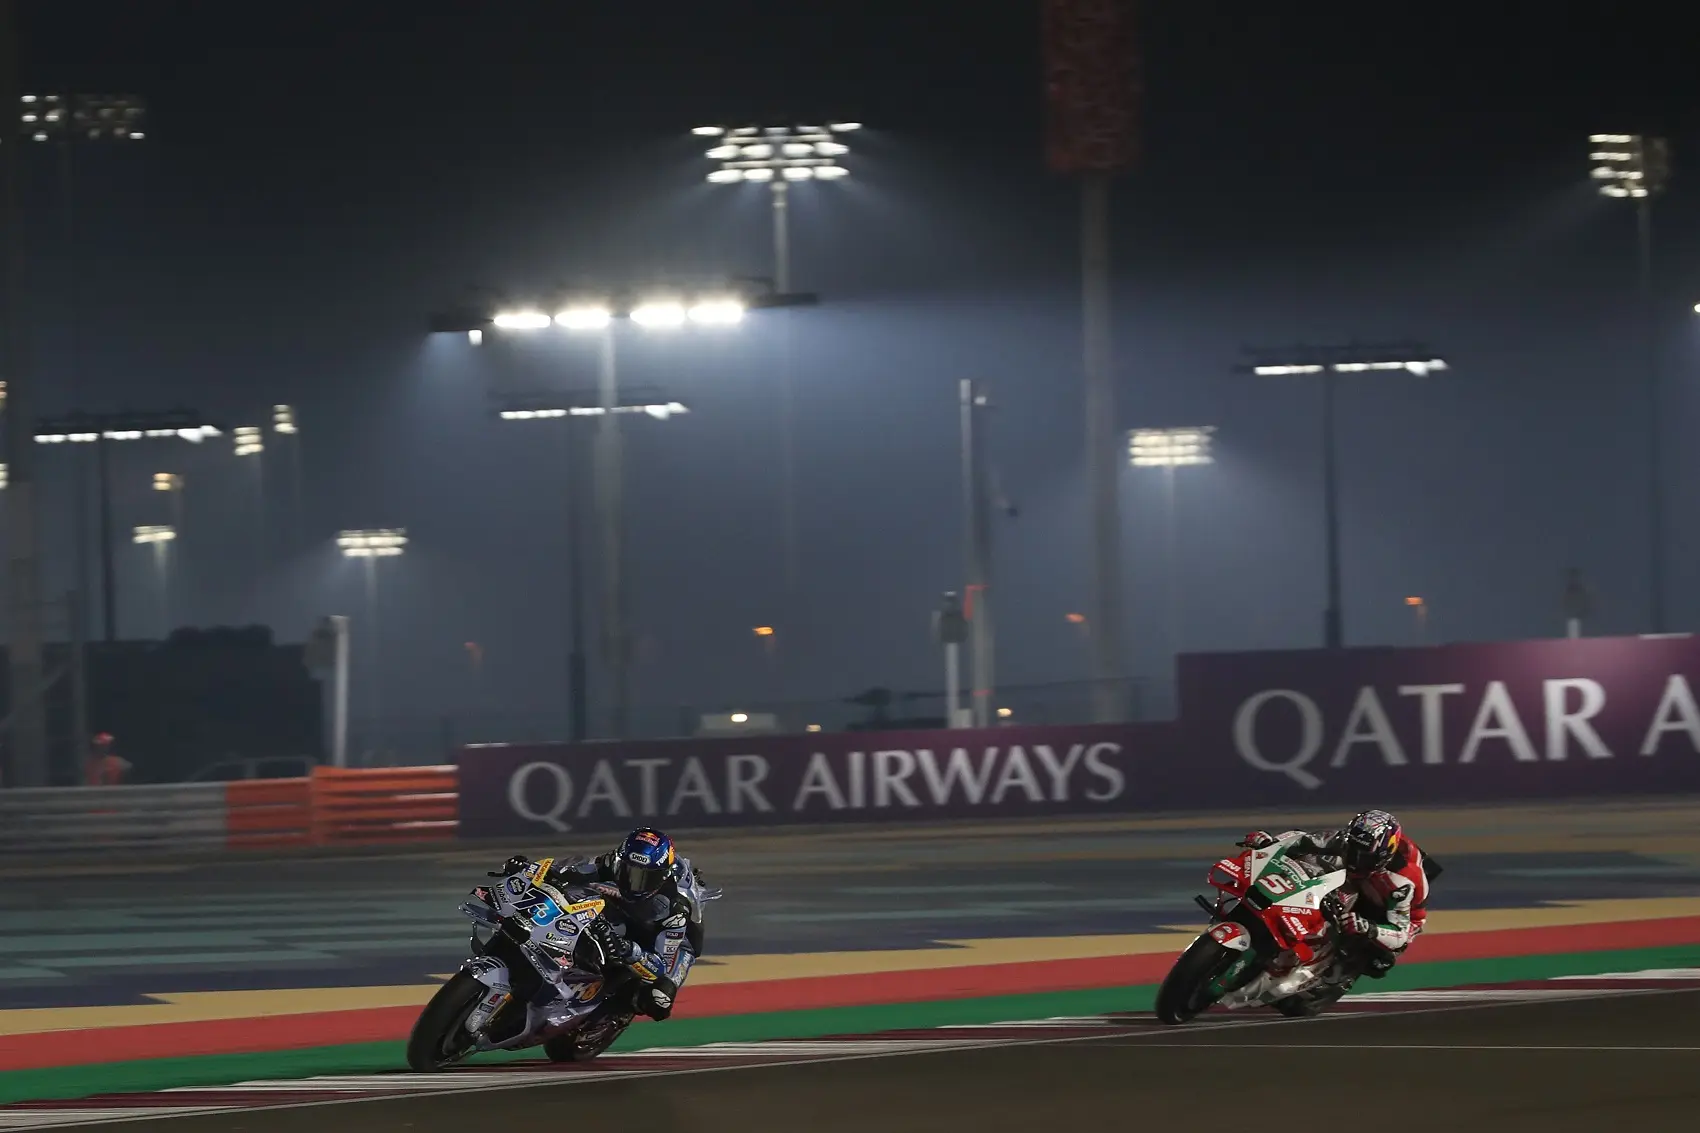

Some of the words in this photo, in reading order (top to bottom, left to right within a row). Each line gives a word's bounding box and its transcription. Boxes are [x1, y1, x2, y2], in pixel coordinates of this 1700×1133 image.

[1232, 677, 1614, 790] QATAR
[507, 754, 774, 832] QATAR
[793, 742, 1125, 811] AIRWAYS
[1243, 855, 1251, 878] SENA
[1270, 858, 1307, 889] CUSTOM
[1256, 873, 1295, 895] 5
[510, 888, 564, 926] 73
[1282, 907, 1312, 916] SENA
